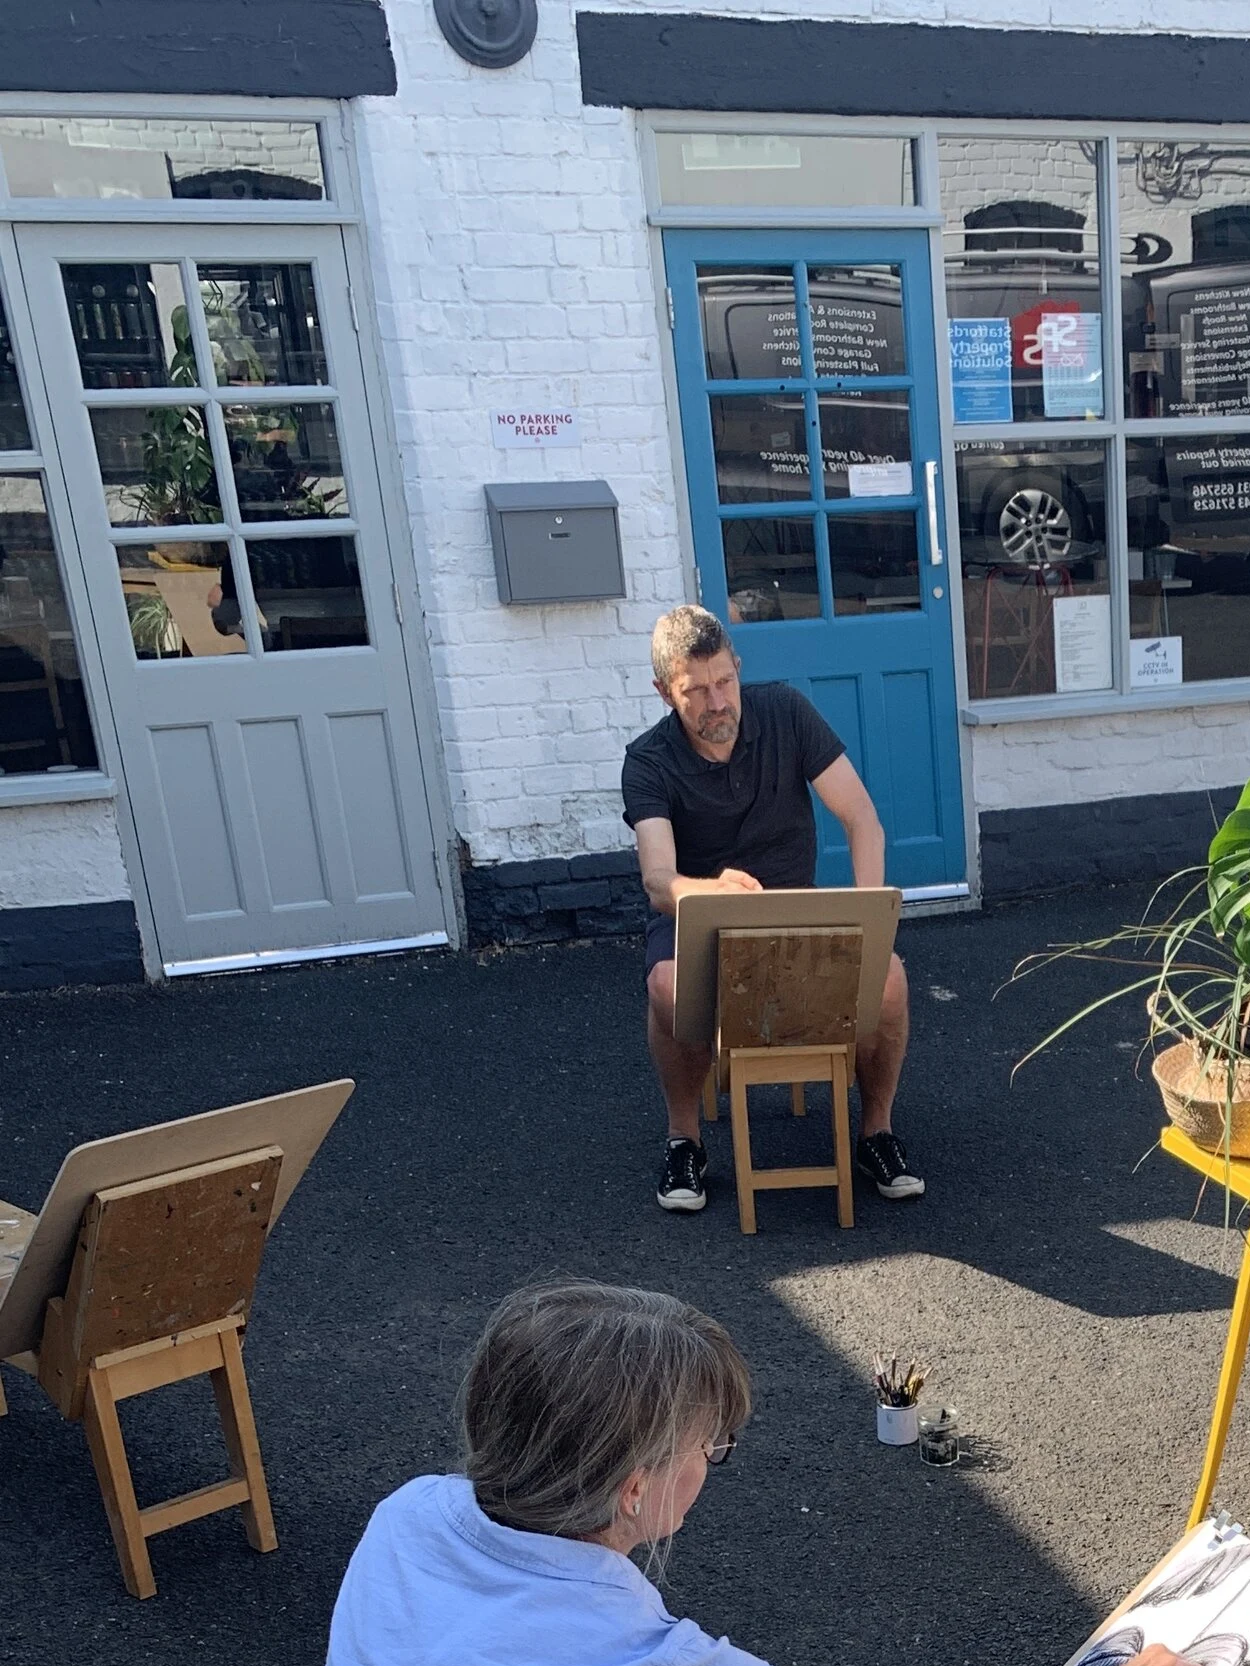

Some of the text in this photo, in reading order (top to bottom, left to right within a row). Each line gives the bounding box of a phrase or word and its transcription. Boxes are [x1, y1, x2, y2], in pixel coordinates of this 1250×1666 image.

[497, 414, 573, 425] NO PARKING
[515, 425, 558, 436] PLEASE
